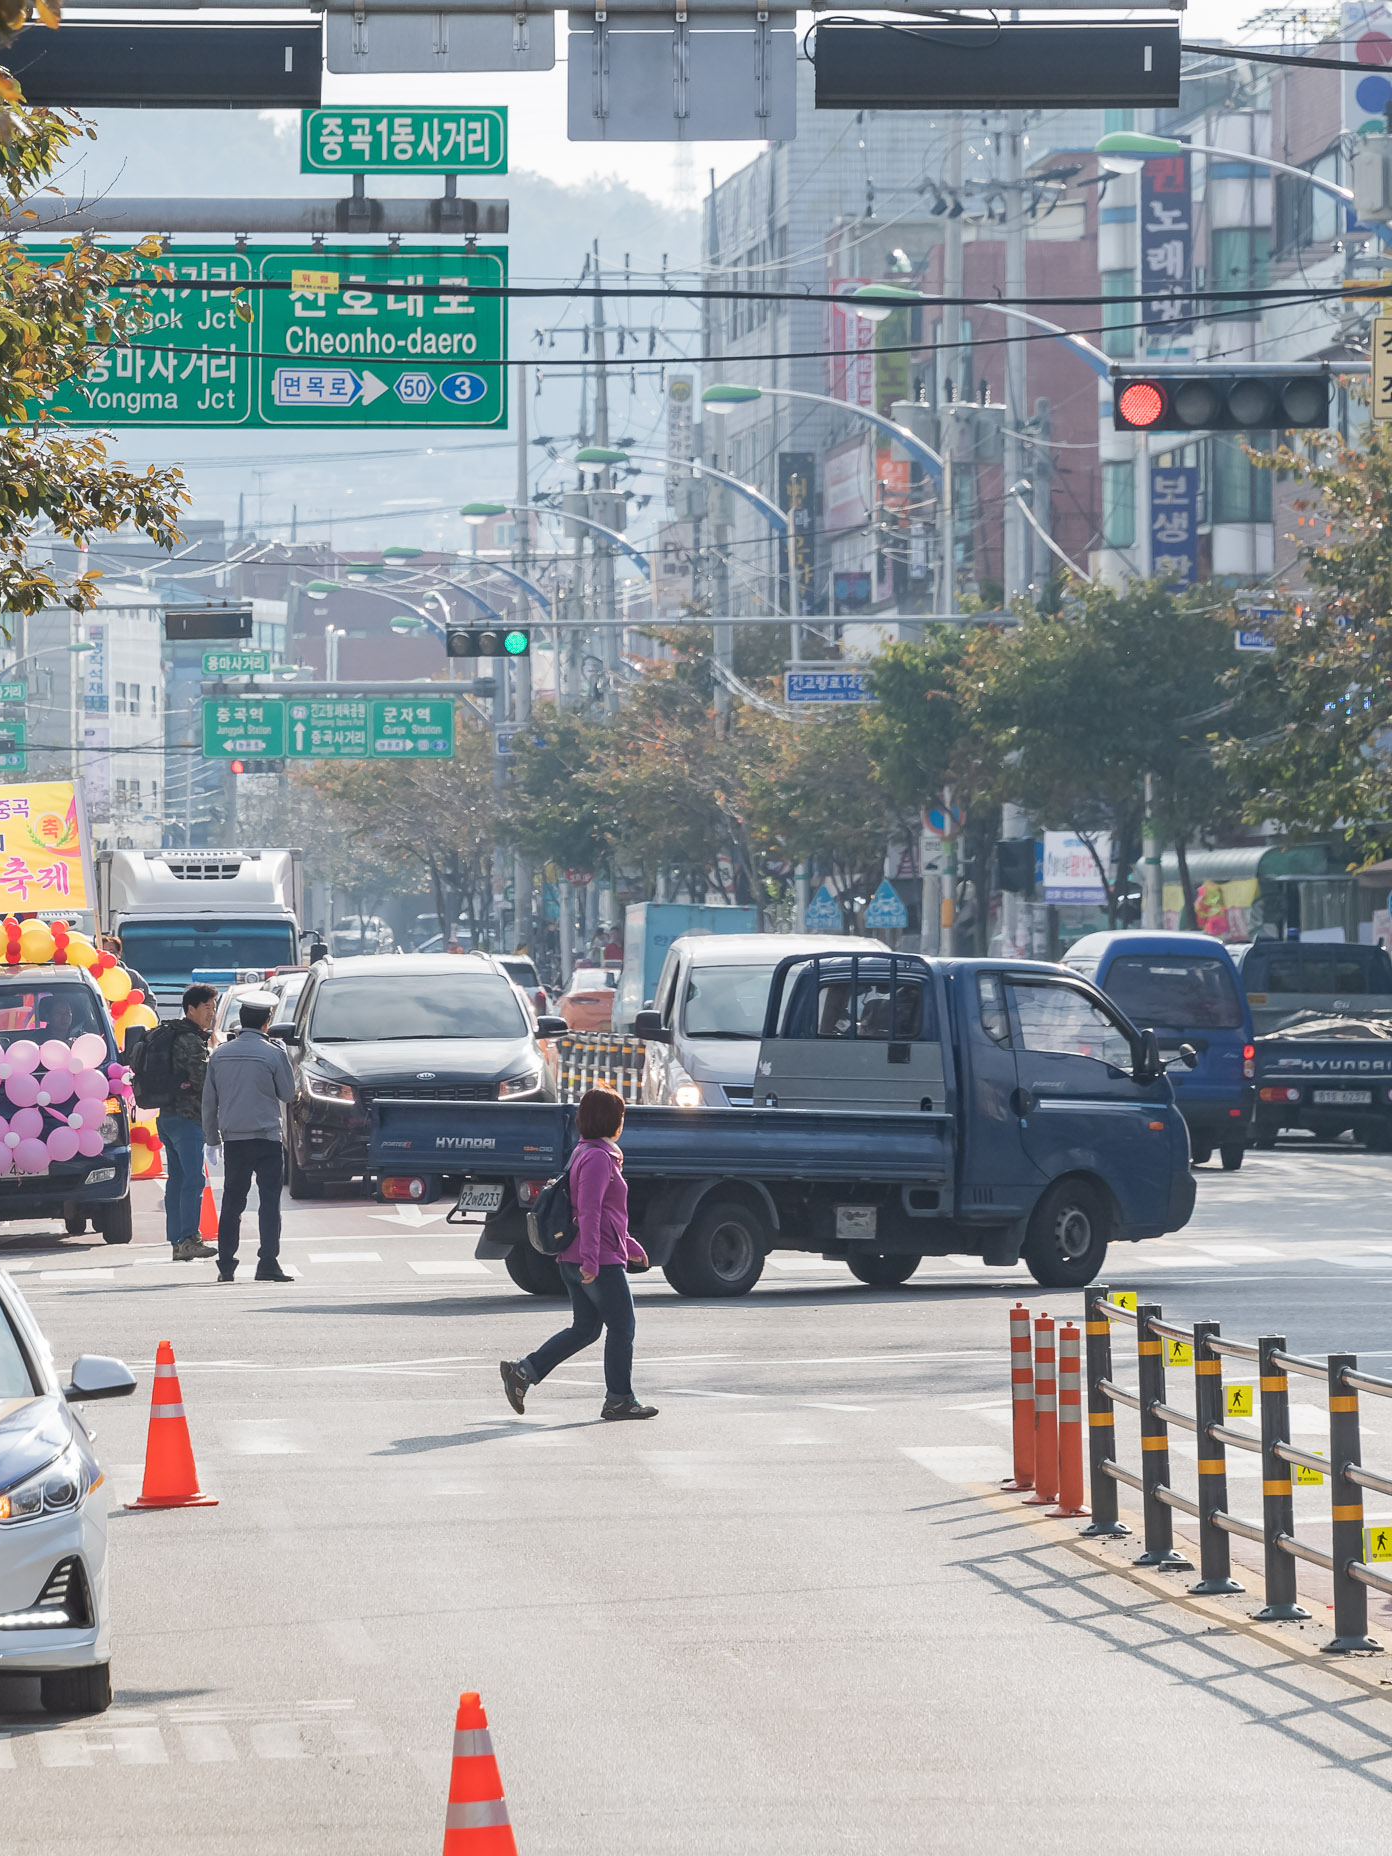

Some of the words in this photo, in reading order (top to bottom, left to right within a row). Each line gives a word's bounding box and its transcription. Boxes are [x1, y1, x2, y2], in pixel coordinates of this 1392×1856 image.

[319, 117, 490, 162] 중곡1동사거리
[197, 308, 237, 330] Jct
[285, 325, 478, 355] Cheonho-daero
[283, 376, 349, 398] 면목로
[403, 378, 428, 398] 50
[454, 375, 473, 400] 3
[87, 387, 179, 414] Yongma
[197, 388, 236, 410] Jct
[207, 655, 266, 672] 용마사거리
[216, 707, 264, 723] 중곡역
[383, 706, 431, 723] 군자역
[42, 819, 60, 839] 축
[435, 1137, 496, 1150] HYUNDAI
